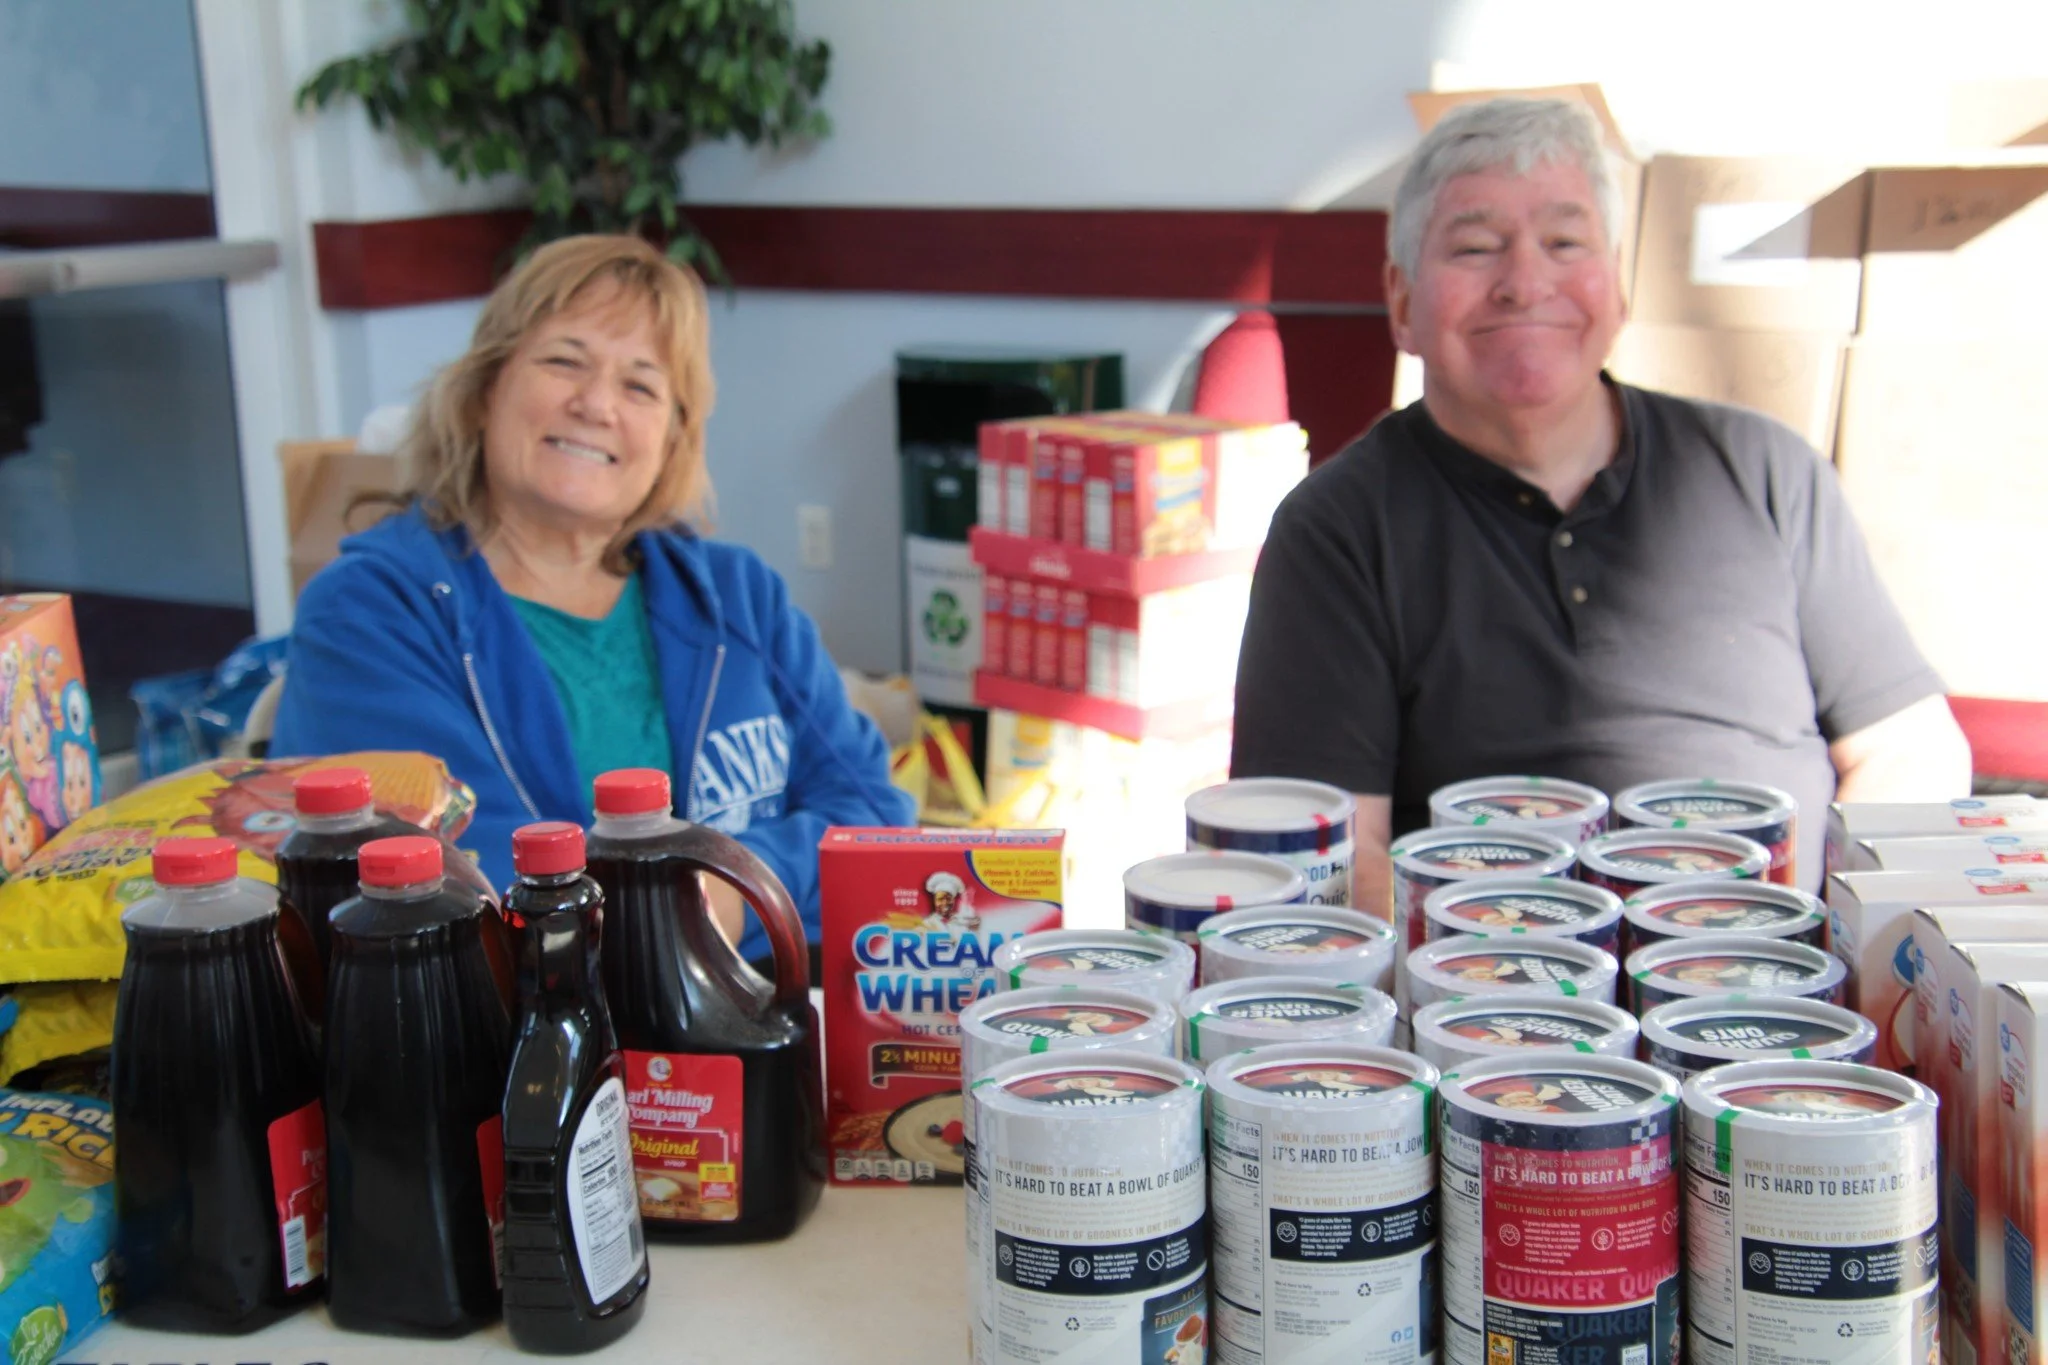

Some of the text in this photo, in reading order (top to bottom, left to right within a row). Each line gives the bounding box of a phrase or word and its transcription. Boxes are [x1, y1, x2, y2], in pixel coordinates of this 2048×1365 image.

[1700, 1025, 1766, 1042] OATS
[627, 1087, 714, 1114] arl Milling
[1314, 1131, 1345, 1144] COMES
[1300, 1148, 1337, 1164] HARD
[1341, 1148, 1358, 1164] TO
[1561, 1157, 1573, 1168] TO
[1024, 1162, 1054, 1177] COMES
[1241, 1163, 1260, 1179] 150
[1493, 1164, 1517, 1183] IT'S
[1520, 1169, 1557, 1185] HARD
[1561, 1171, 1578, 1185] TO
[1581, 1169, 1614, 1185] BEAT
[1616, 1168, 1625, 1182] A
[1744, 1158, 1773, 1173] WHEN
[1775, 1161, 1785, 1174] IT
[1788, 1162, 1824, 1176] COMES
[1827, 1163, 1841, 1175] TO
[995, 1168, 1012, 1187] IT'S
[1015, 1175, 1046, 1195] HARD
[1048, 1180, 1065, 1197] TO
[1069, 1181, 1102, 1198] BEAT
[1106, 1182, 1115, 1197] A
[1118, 1175, 1154, 1195] BOWL
[1156, 1171, 1170, 1189] OF
[1463, 1179, 1480, 1195] 150
[1744, 1173, 1770, 1191] IT'S
[1773, 1178, 1814, 1195] HARD
[1818, 1180, 1837, 1195] TO
[1842, 1179, 1875, 1196] BEAT
[1879, 1177, 1888, 1193] A
[1312, 1194, 1344, 1207] WHOLE
[1712, 1187, 1731, 1206] 150
[1525, 1204, 1551, 1217] WHOLE
[1553, 1206, 1567, 1217] LOT
[1568, 1207, 1578, 1217] OF
[1580, 1205, 1619, 1217] NUTRITION
[1619, 1203, 1628, 1214] IN
[1024, 1223, 1051, 1238] WHOLE
[1053, 1228, 1070, 1240] LOT
[1072, 1229, 1083, 1241] OF
[1086, 1227, 1135, 1241] GOODNESS
[1744, 1222, 1777, 1238] THAT'S
[1777, 1226, 1785, 1239] A
[1787, 1227, 1822, 1242] WHOLE
[1824, 1228, 1844, 1242] LOT
[1845, 1228, 1858, 1242] OF
[1495, 1271, 1606, 1301] QUAKER
